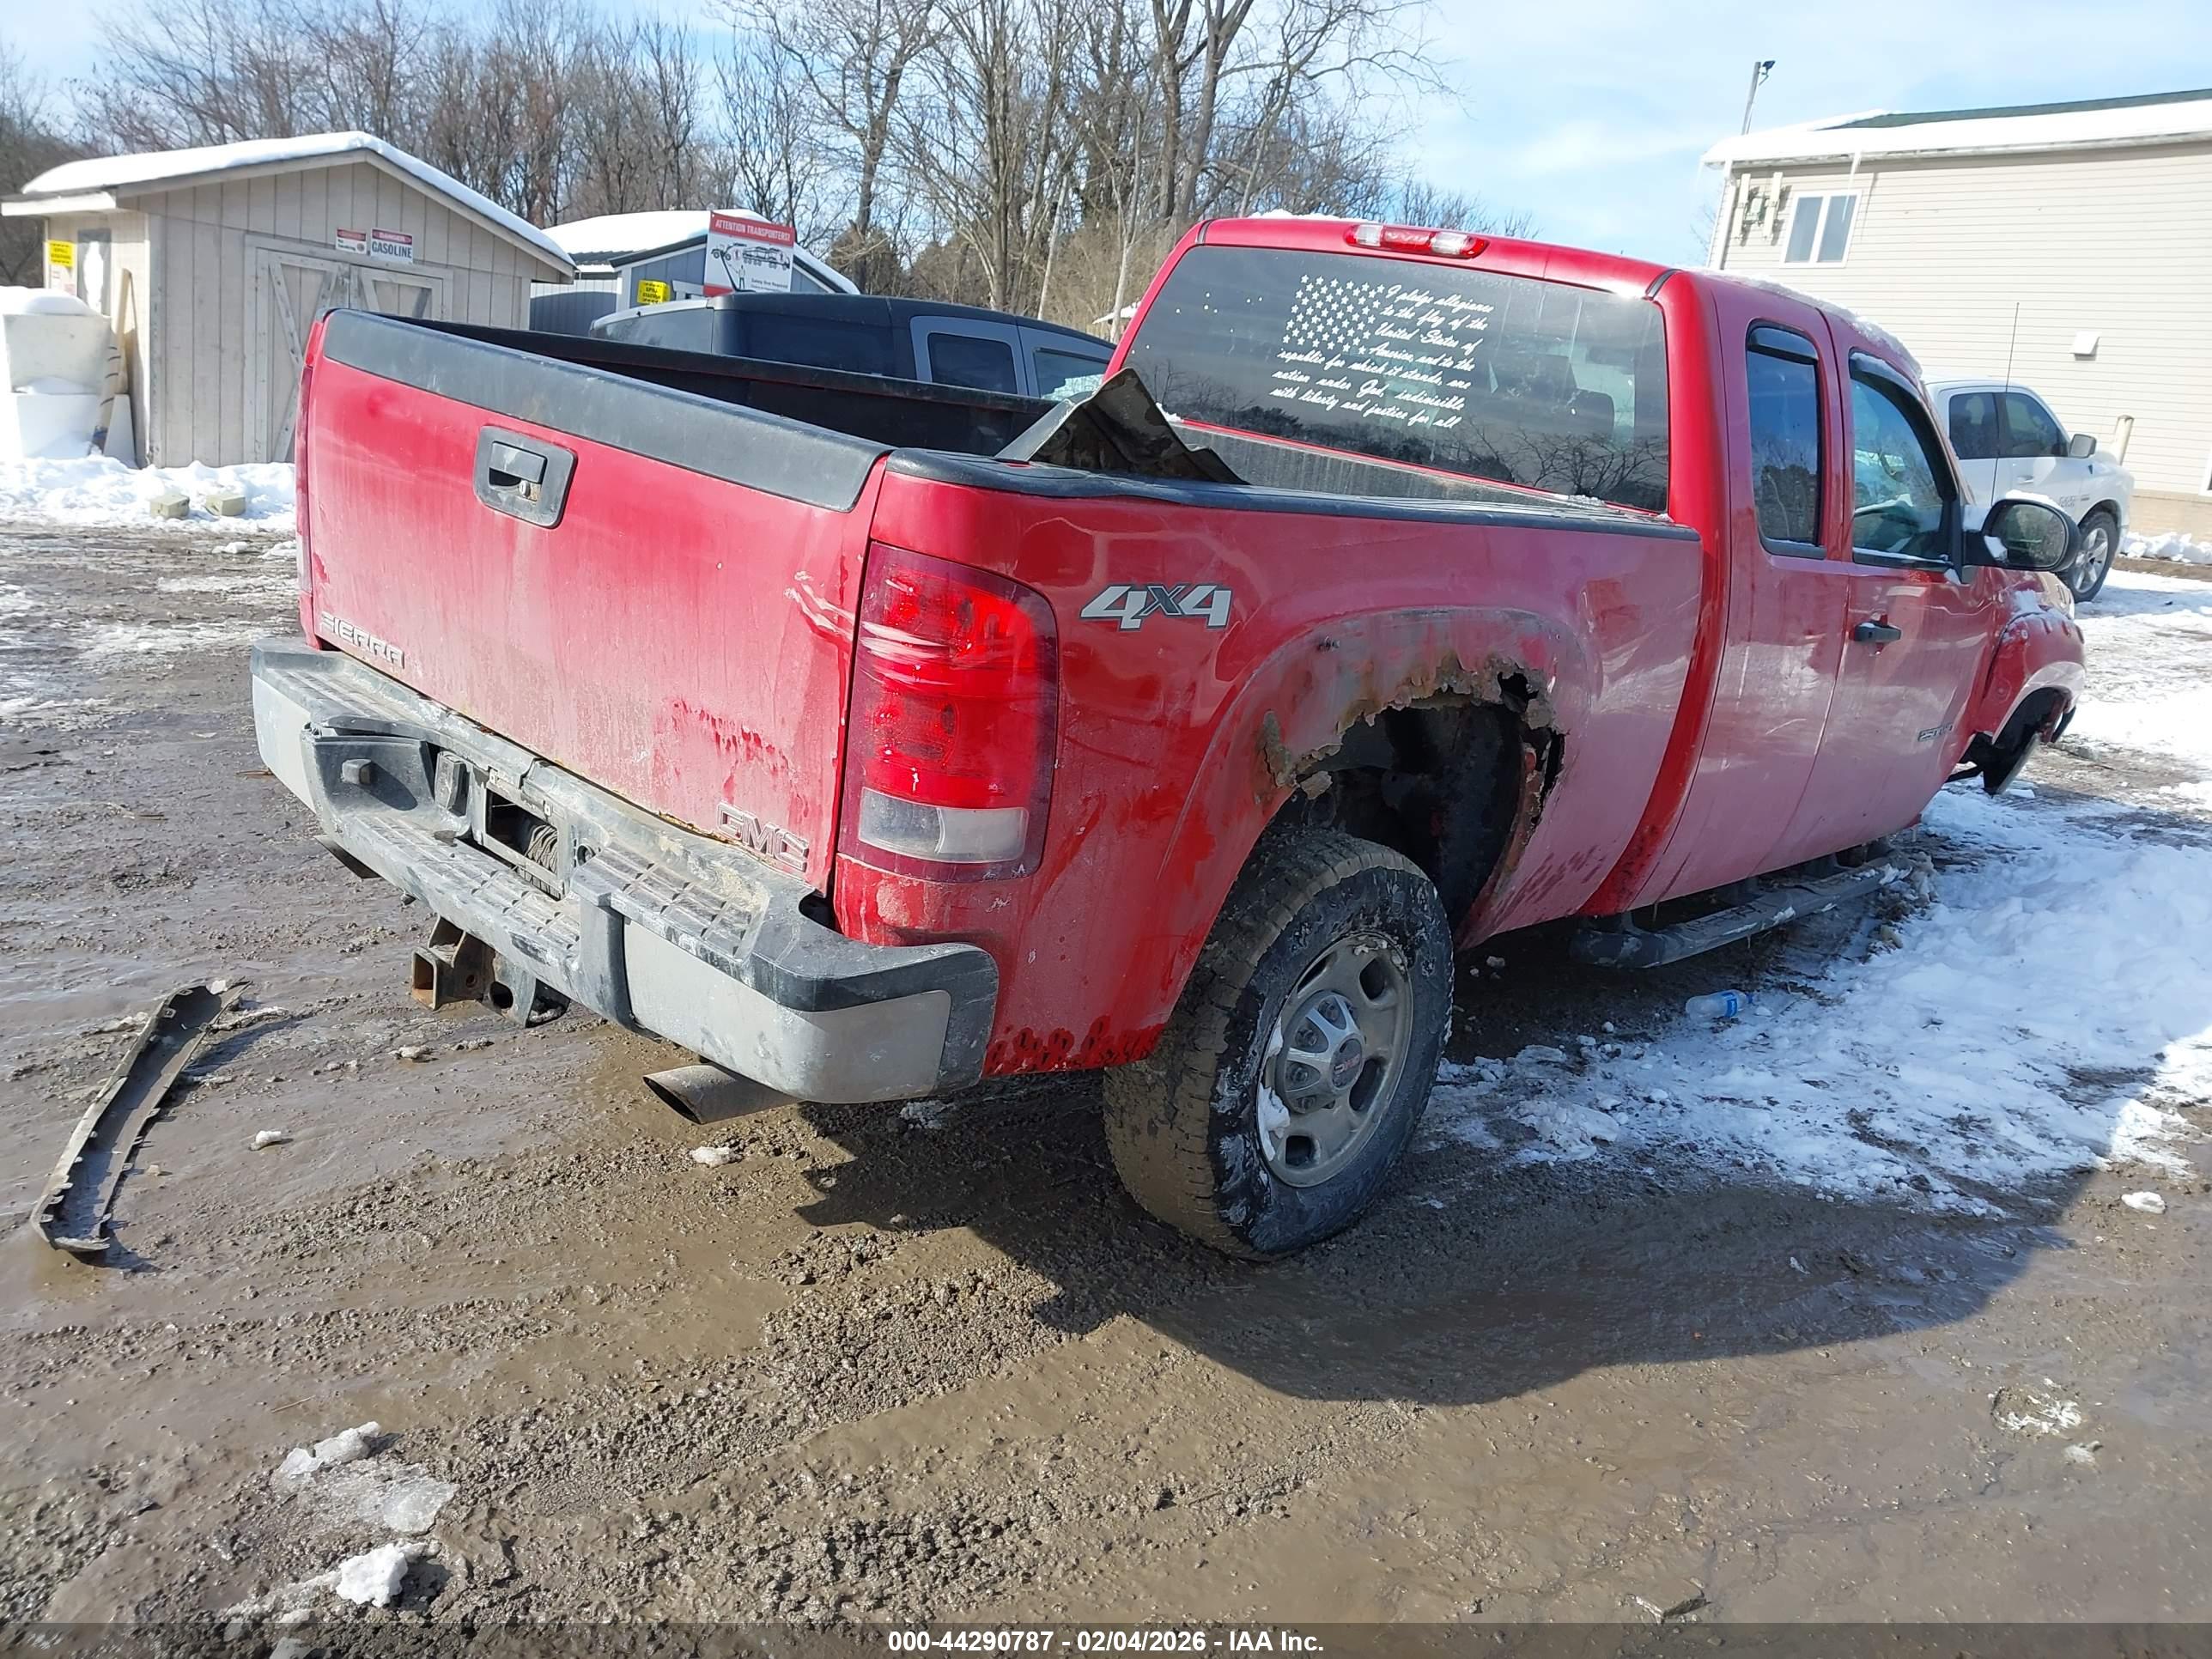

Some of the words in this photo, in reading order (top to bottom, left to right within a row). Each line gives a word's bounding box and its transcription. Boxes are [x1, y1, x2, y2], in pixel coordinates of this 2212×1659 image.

[715, 220, 746, 233] ATTENTION
[372, 241, 412, 258] GASOLINE
[1379, 304, 1395, 316] to
[1393, 306, 1416, 319] the
[1416, 308, 1445, 328] flag
[1448, 314, 1471, 331] of
[1465, 317, 1488, 330] the
[1394, 289, 1435, 307] pledge
[1433, 294, 1494, 313] allegiance
[1374, 321, 1419, 340] United
[1419, 329, 1459, 348] States
[1461, 337, 1483, 356] of
[1276, 349, 1326, 364] republic
[1323, 353, 1346, 370] for
[1348, 358, 1389, 374] which
[1382, 364, 1404, 376] it
[1446, 380, 1471, 390] one
[1414, 353, 1447, 366] and
[1438, 356, 1455, 368] to
[1453, 357, 1475, 372] the
[1269, 386, 1300, 399] with
[1298, 389, 1340, 411] liberty
[1340, 399, 1371, 411] and
[1363, 404, 1408, 419] justice
[1407, 409, 1430, 427] for
[1432, 416, 1462, 428] all
[1272, 369, 1310, 383] nation
[1316, 376, 1352, 391] under
[1395, 390, 1466, 411] indivisible
[319, 611, 405, 670] SIERRA
[716, 799, 810, 874] GMC
